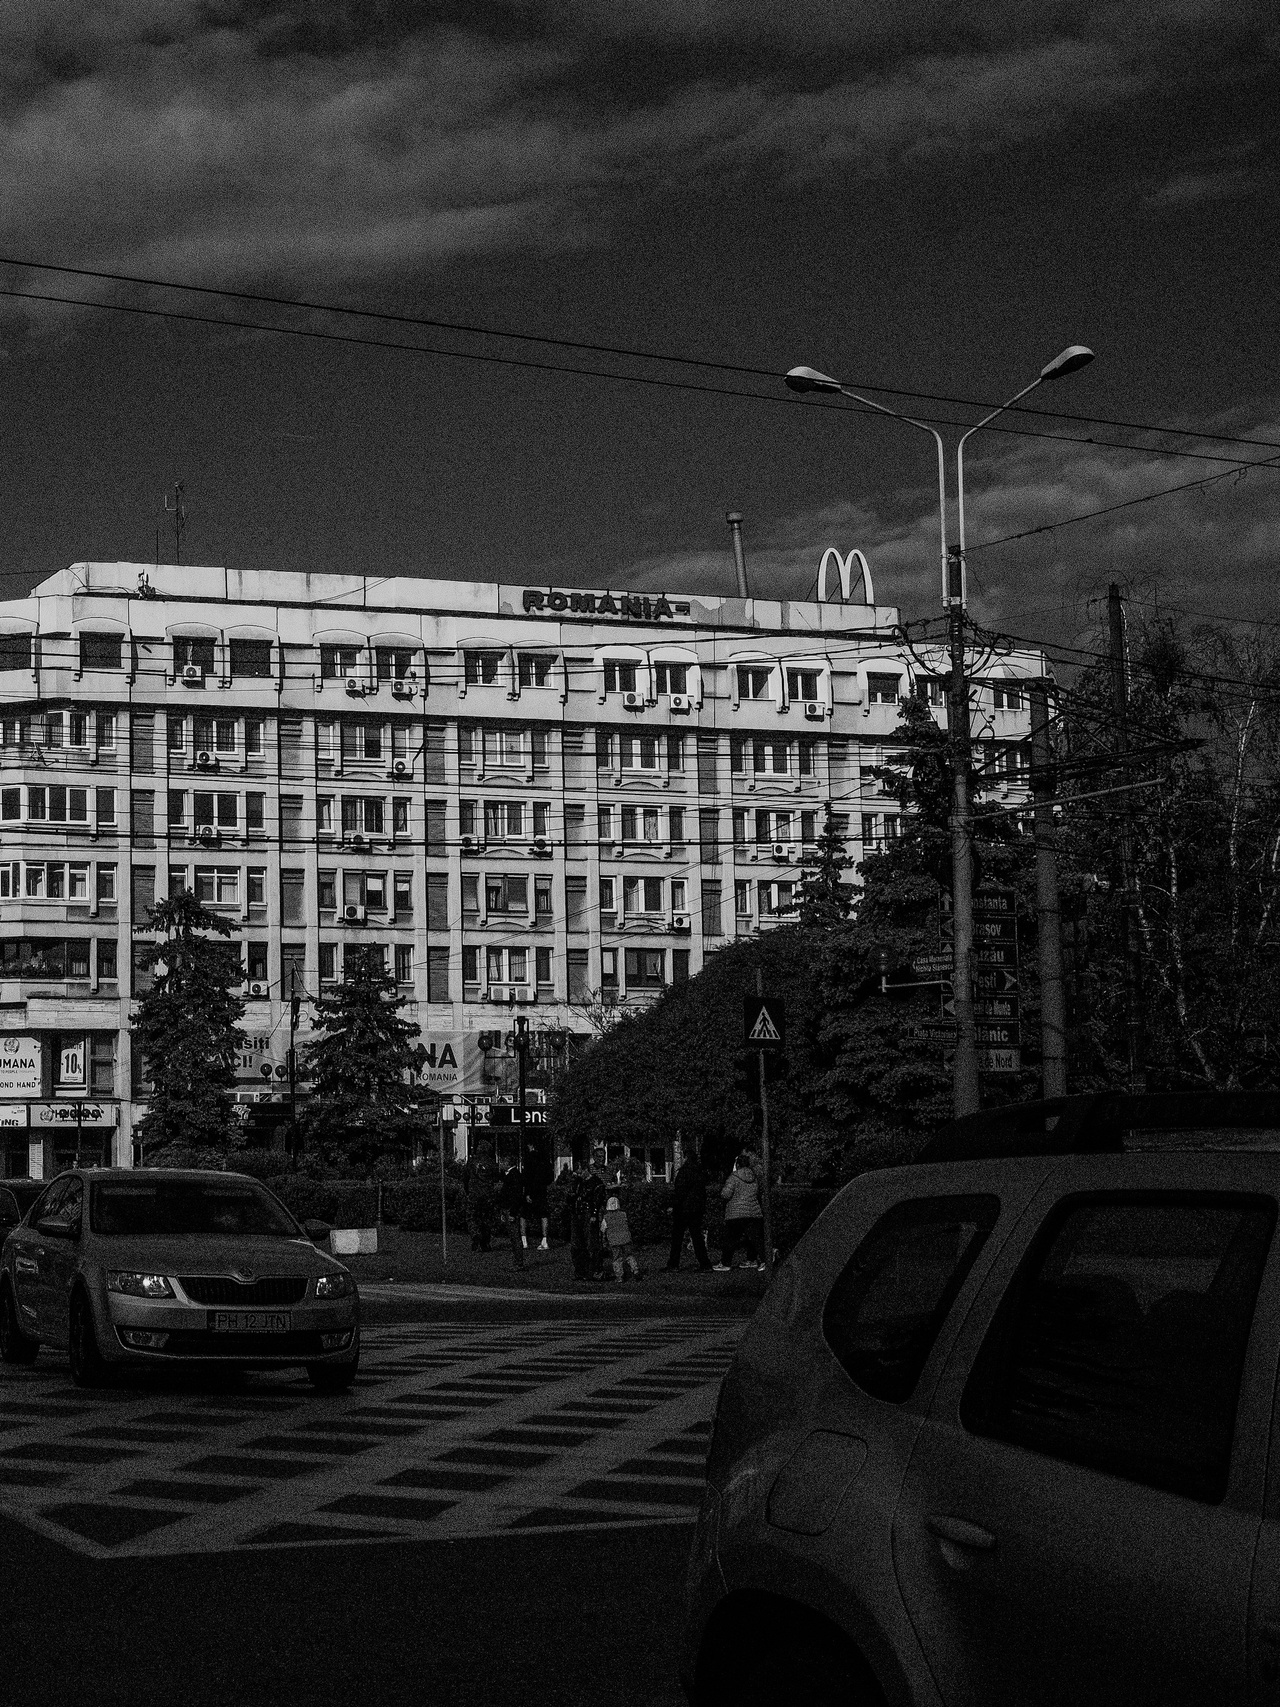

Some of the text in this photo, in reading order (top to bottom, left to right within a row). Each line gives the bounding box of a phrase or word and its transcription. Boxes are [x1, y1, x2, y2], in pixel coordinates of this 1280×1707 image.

[522, 589, 673, 620] ROMANIA
[218, 1314, 286, 1329] PH 12 JTN
